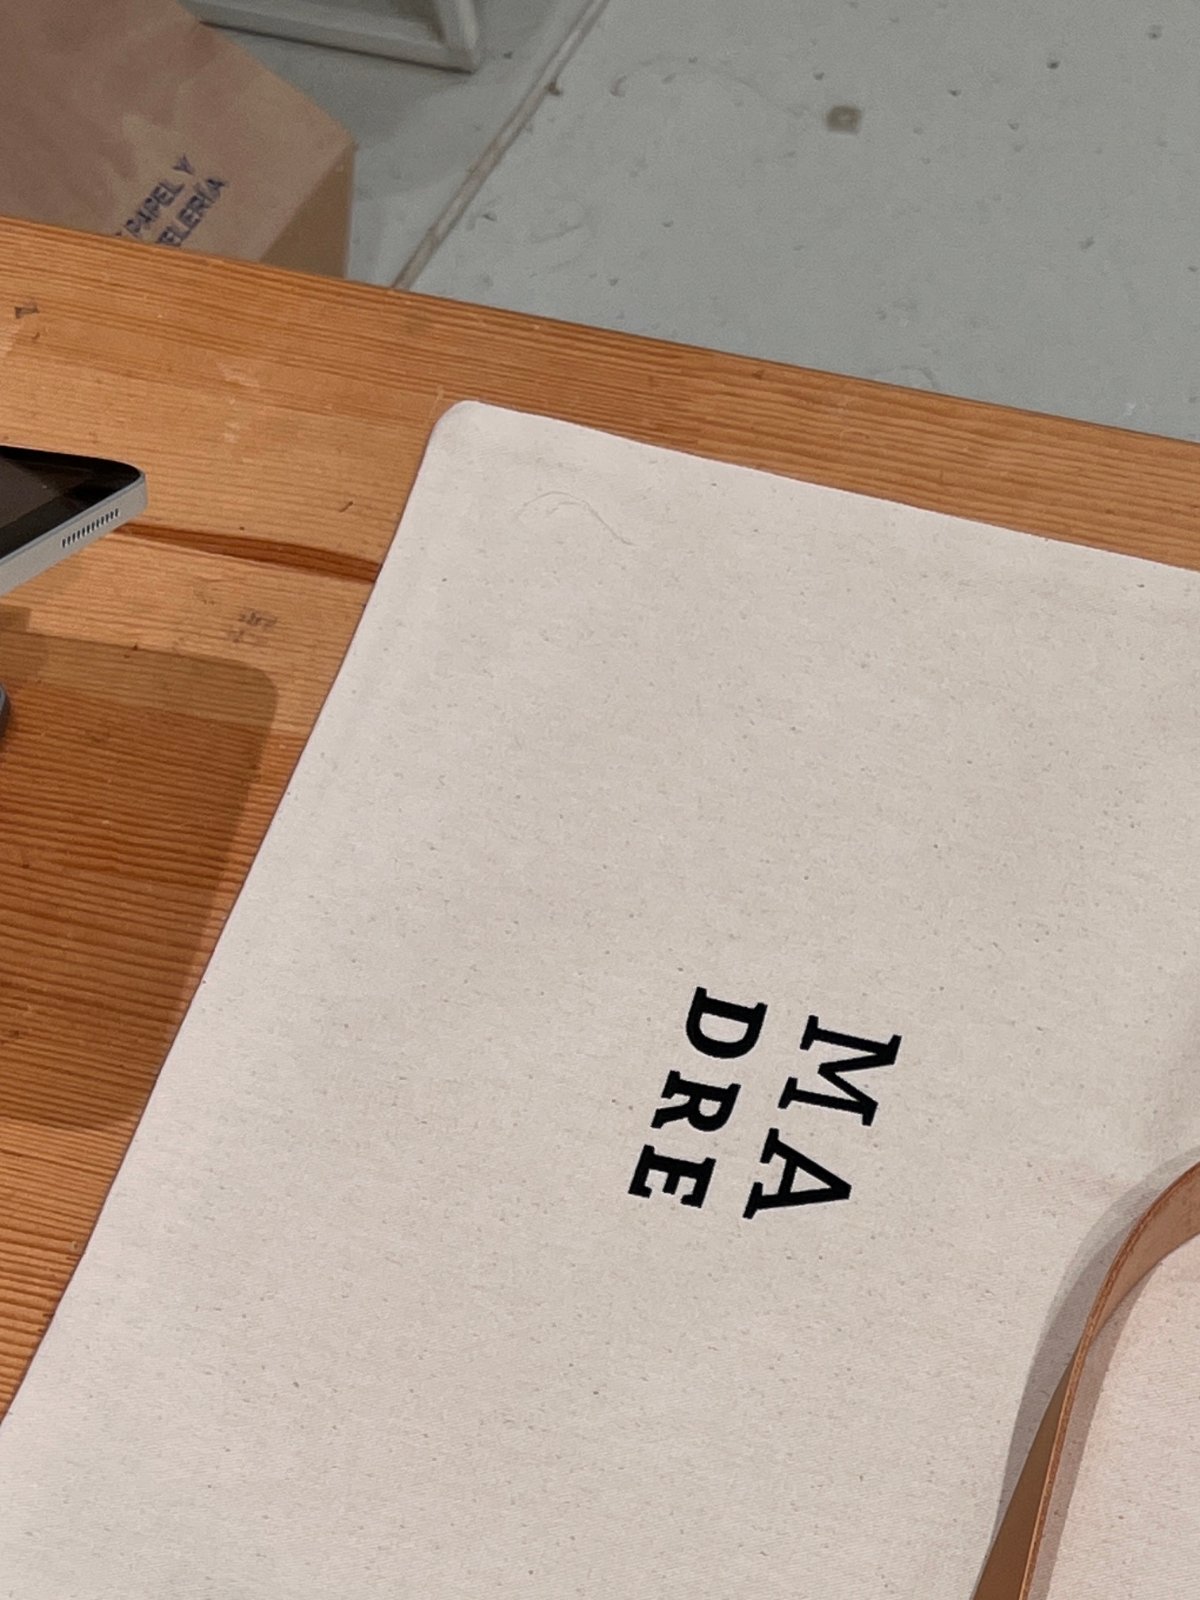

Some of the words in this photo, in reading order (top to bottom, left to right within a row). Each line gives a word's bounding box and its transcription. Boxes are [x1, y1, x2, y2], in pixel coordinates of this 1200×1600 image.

[124, 180, 185, 238] PAPEL
[172, 154, 194, 175] Y
[628, 986, 768, 1208] DRE
[743, 1015, 902, 1219] MA
